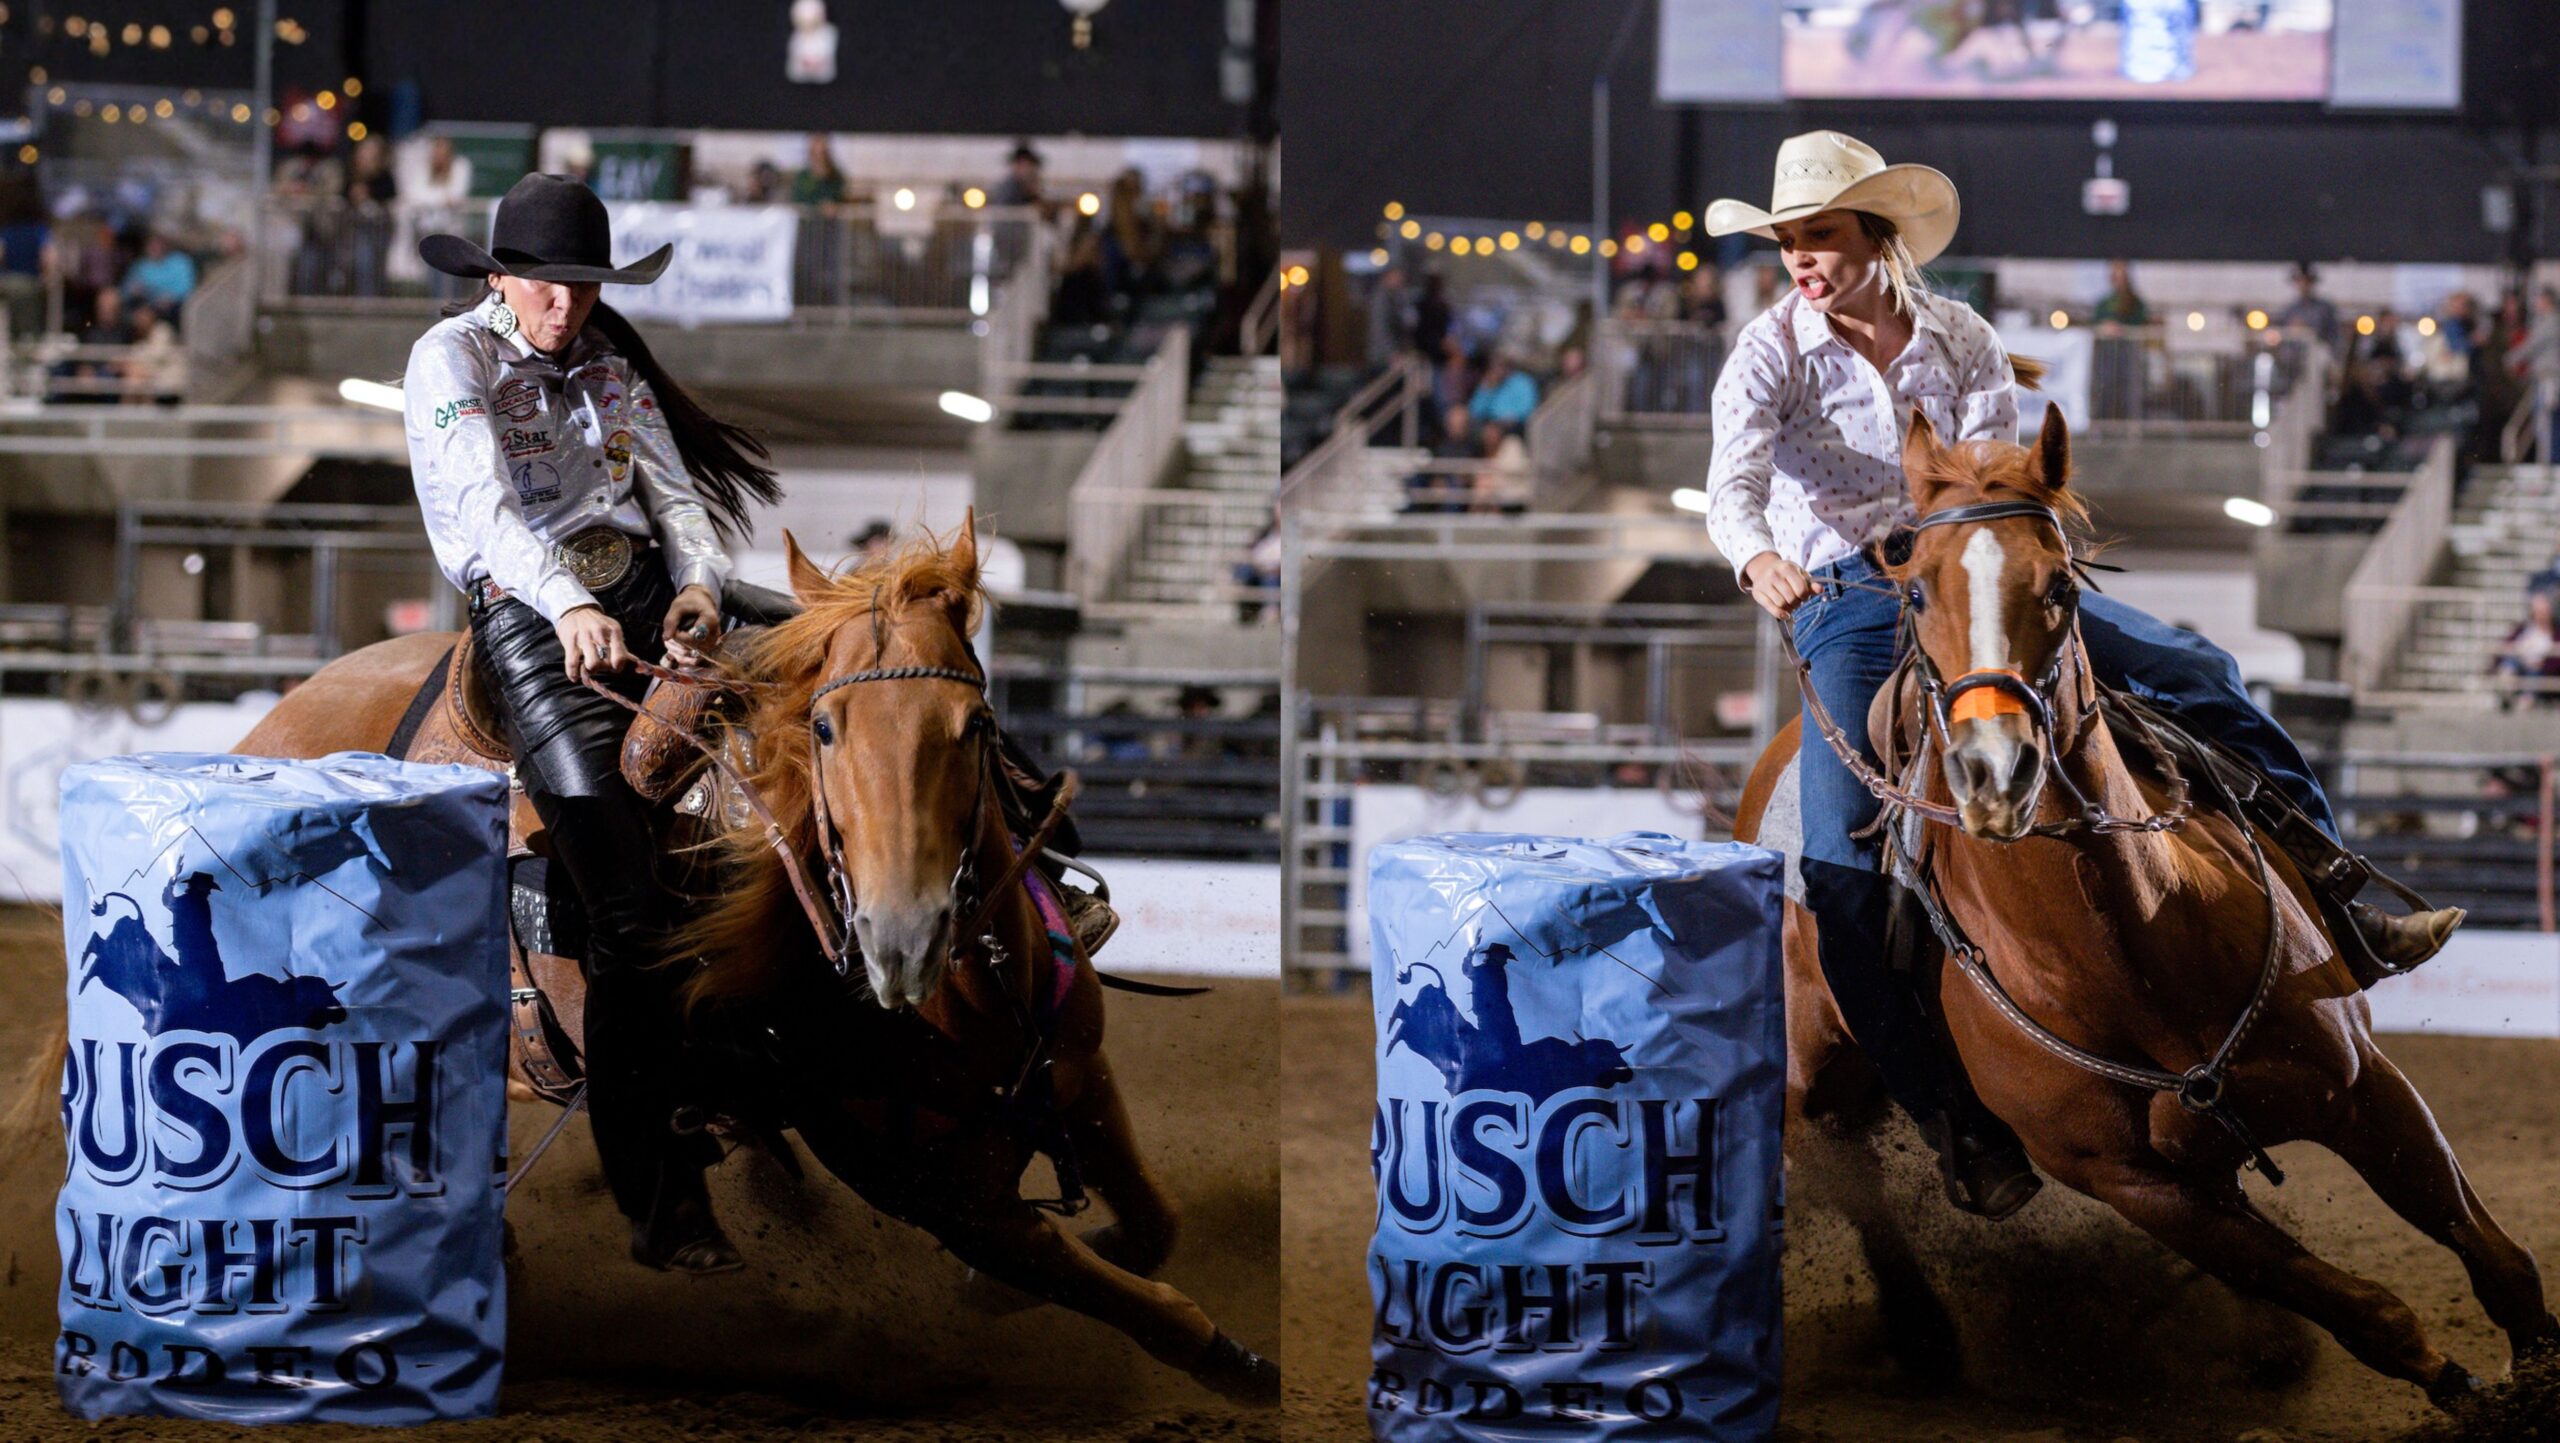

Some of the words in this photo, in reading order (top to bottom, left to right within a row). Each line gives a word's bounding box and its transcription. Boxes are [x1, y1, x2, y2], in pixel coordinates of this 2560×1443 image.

[496, 397, 524, 411] LOCAL
[513, 430, 548, 445] Star
[68, 1208, 367, 1315] LIGHT
[1377, 1255, 1655, 1356] LIGHT
